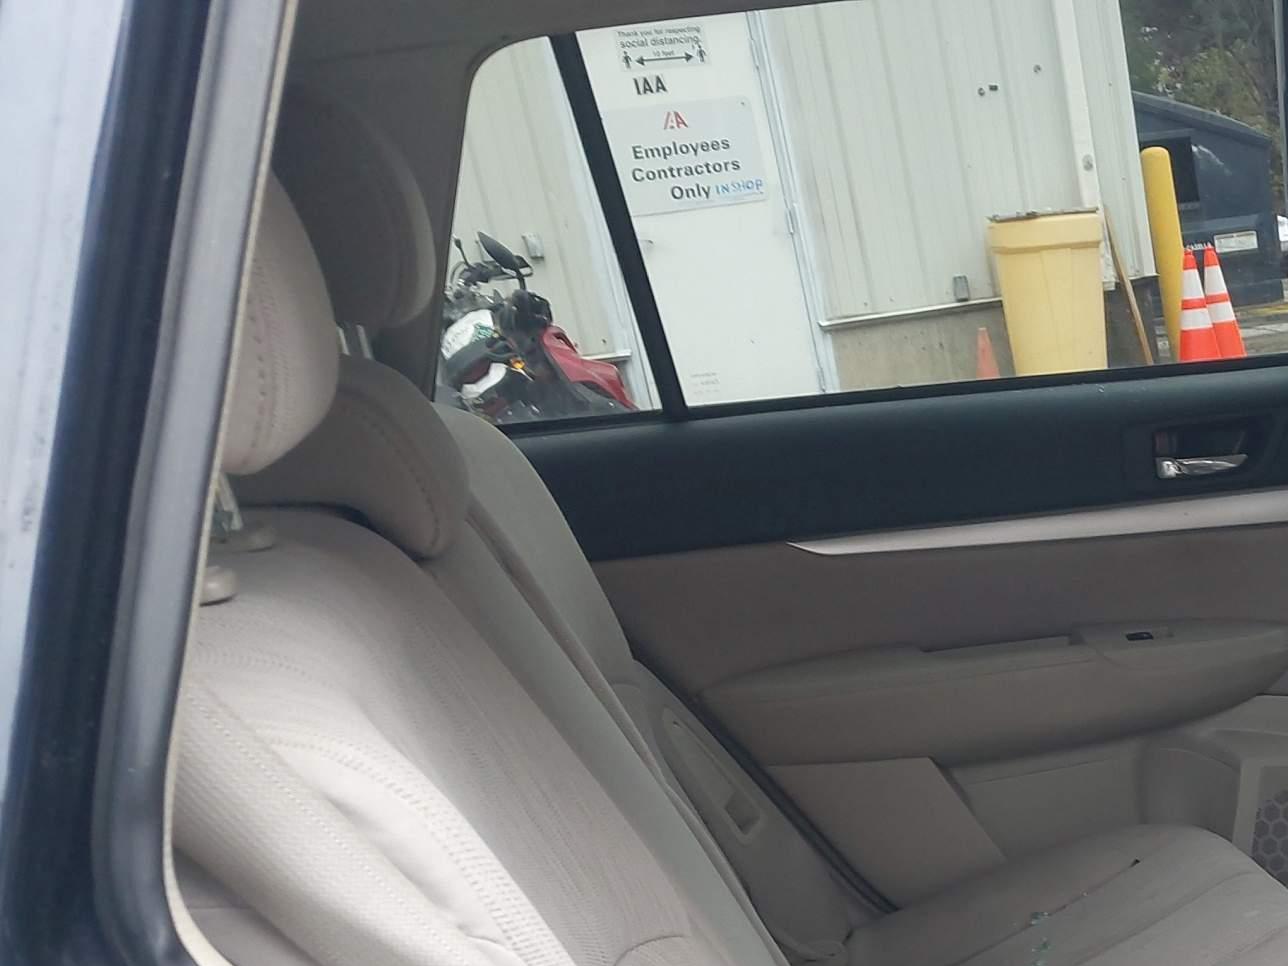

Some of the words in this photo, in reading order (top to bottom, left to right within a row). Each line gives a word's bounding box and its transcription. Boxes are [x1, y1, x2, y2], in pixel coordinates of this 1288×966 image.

[619, 38, 648, 49] social
[632, 74, 668, 96] IAA
[631, 138, 731, 160] Employees
[631, 159, 741, 183] Contractors
[670, 182, 711, 200] Only
